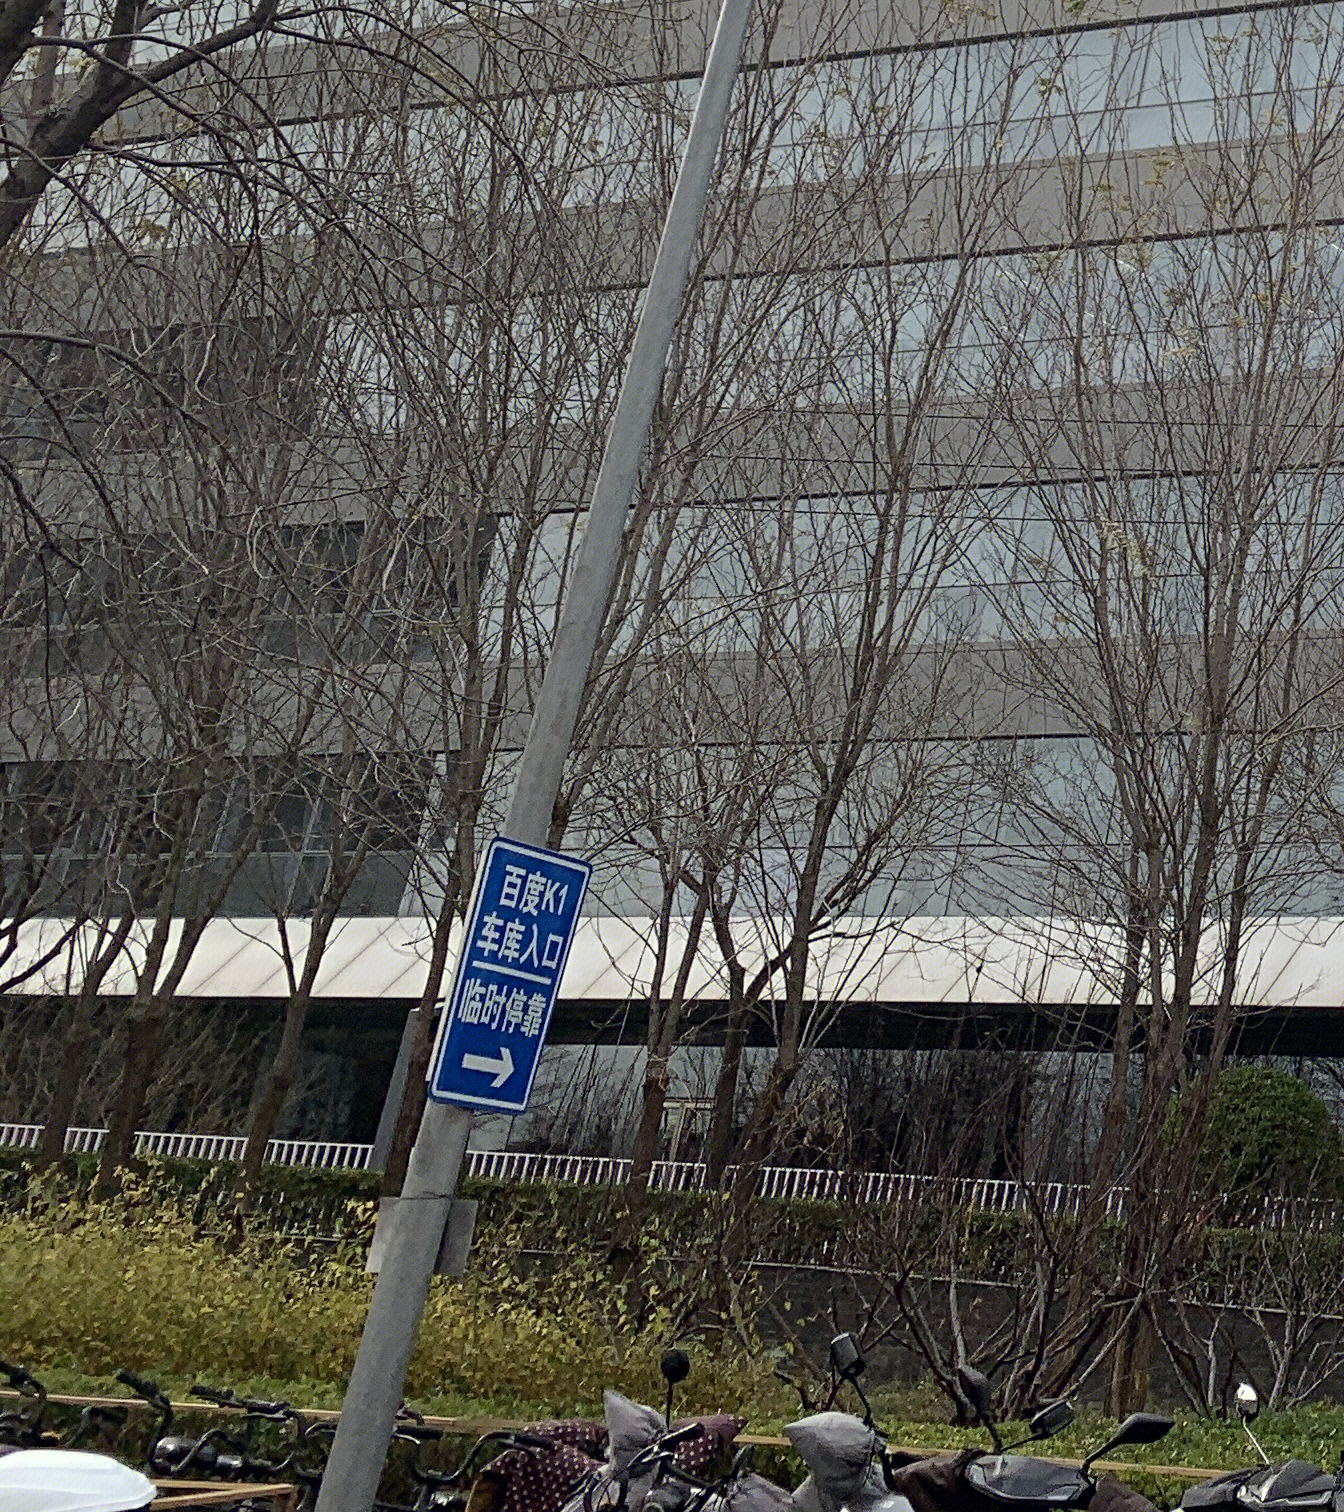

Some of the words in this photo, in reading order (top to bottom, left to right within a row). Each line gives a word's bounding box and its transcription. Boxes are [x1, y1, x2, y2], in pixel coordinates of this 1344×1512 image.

[499, 863, 568, 917] 百度K1
[475, 911, 564, 970] 车库入口
[457, 978, 547, 1038] 临时停靠
